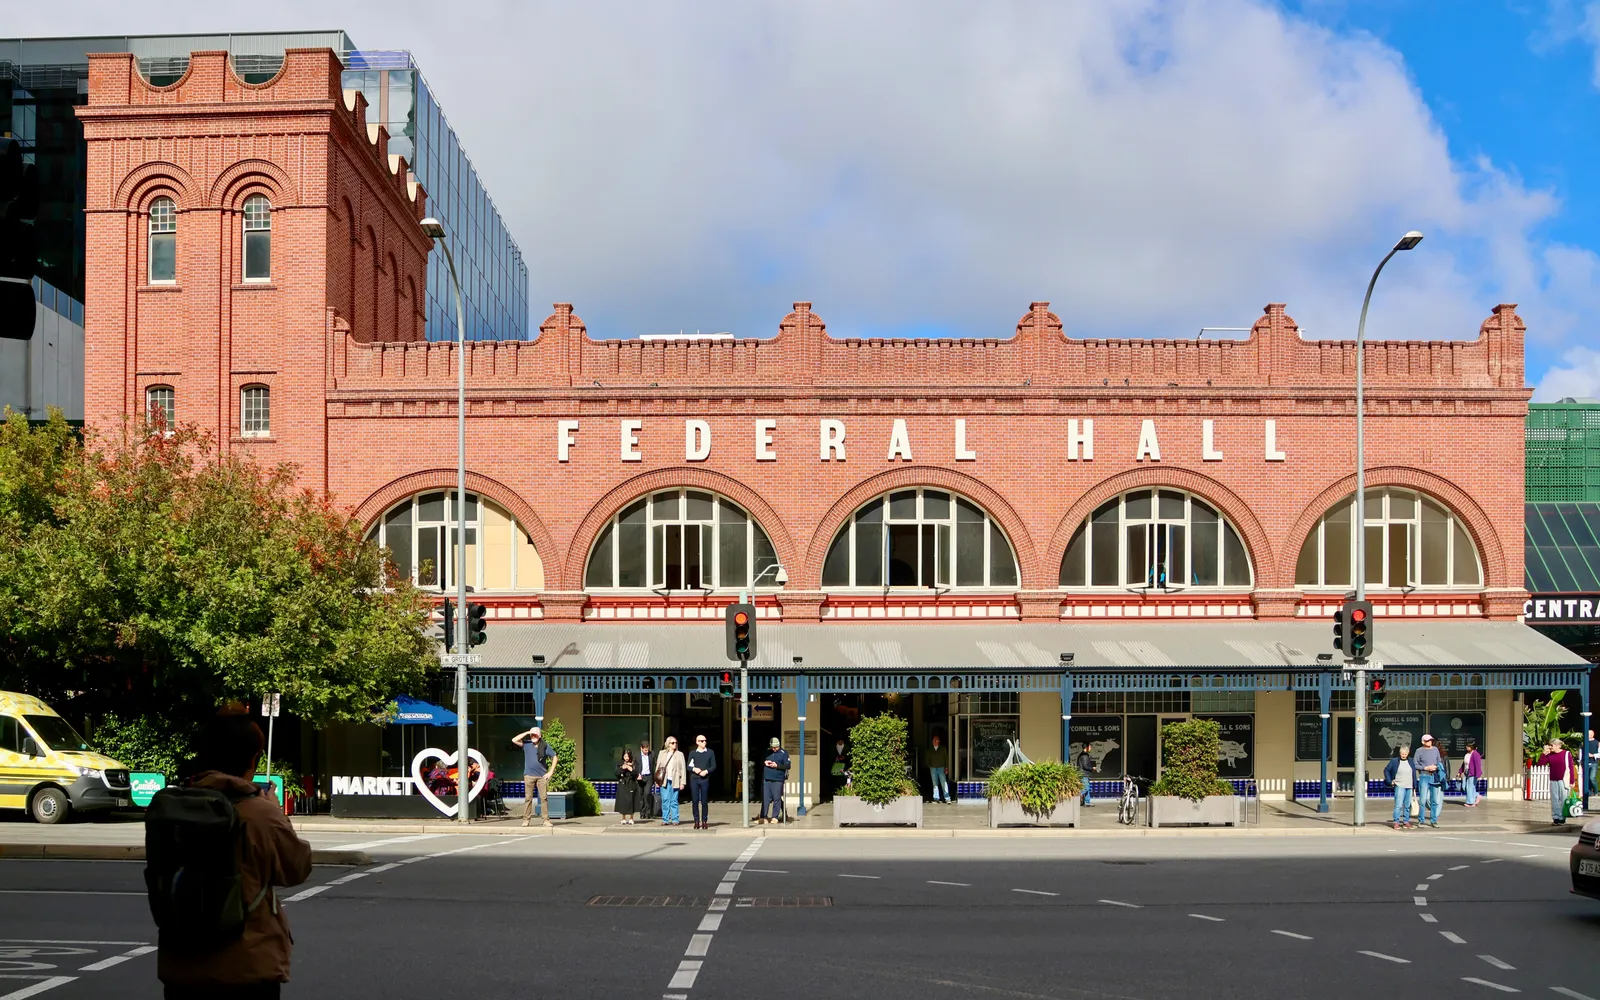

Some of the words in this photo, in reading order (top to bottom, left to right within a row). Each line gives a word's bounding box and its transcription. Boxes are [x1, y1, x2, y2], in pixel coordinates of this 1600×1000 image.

[557, 419, 976, 461] FEDERAL
[1067, 419, 1286, 462] HALL
[332, 776, 415, 795] MARKET
